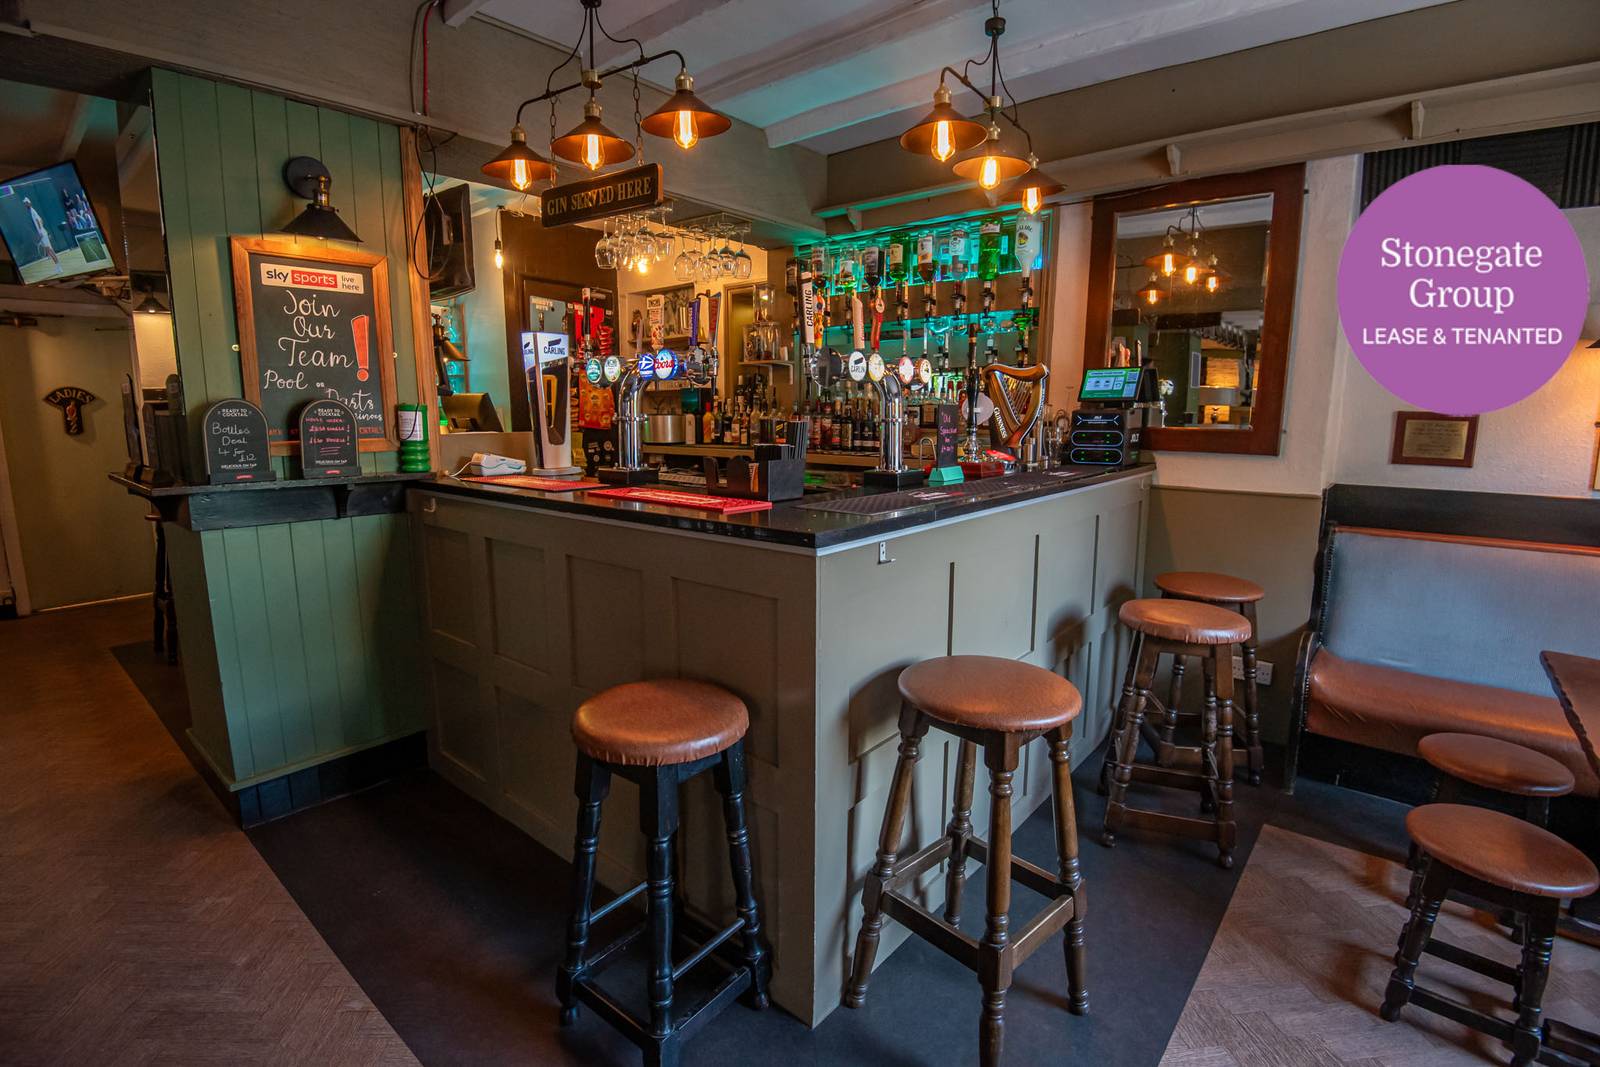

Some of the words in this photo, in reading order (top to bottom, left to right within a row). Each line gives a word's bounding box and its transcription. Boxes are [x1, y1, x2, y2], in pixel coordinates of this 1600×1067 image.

[547, 195, 568, 216] GIN
[571, 184, 615, 211] SERVED
[617, 176, 651, 201] HERE
[266, 269, 288, 283] sky
[293, 273, 336, 287] sports
[341, 275, 355, 283] live
[341, 282, 360, 292] here
[283, 290, 340, 317] Join
[804, 289, 814, 327] CARLING
[293, 316, 335, 339] Our
[278, 337, 354, 368] Team
[543, 345, 566, 356] CARLING
[653, 358, 676, 371] Coors
[264, 369, 308, 390] Pool
[49, 388, 93, 404] LADIES
[993, 406, 1008, 440] GUINNESS
[222, 435, 248, 446] Deal
[218, 447, 230, 457] 4
